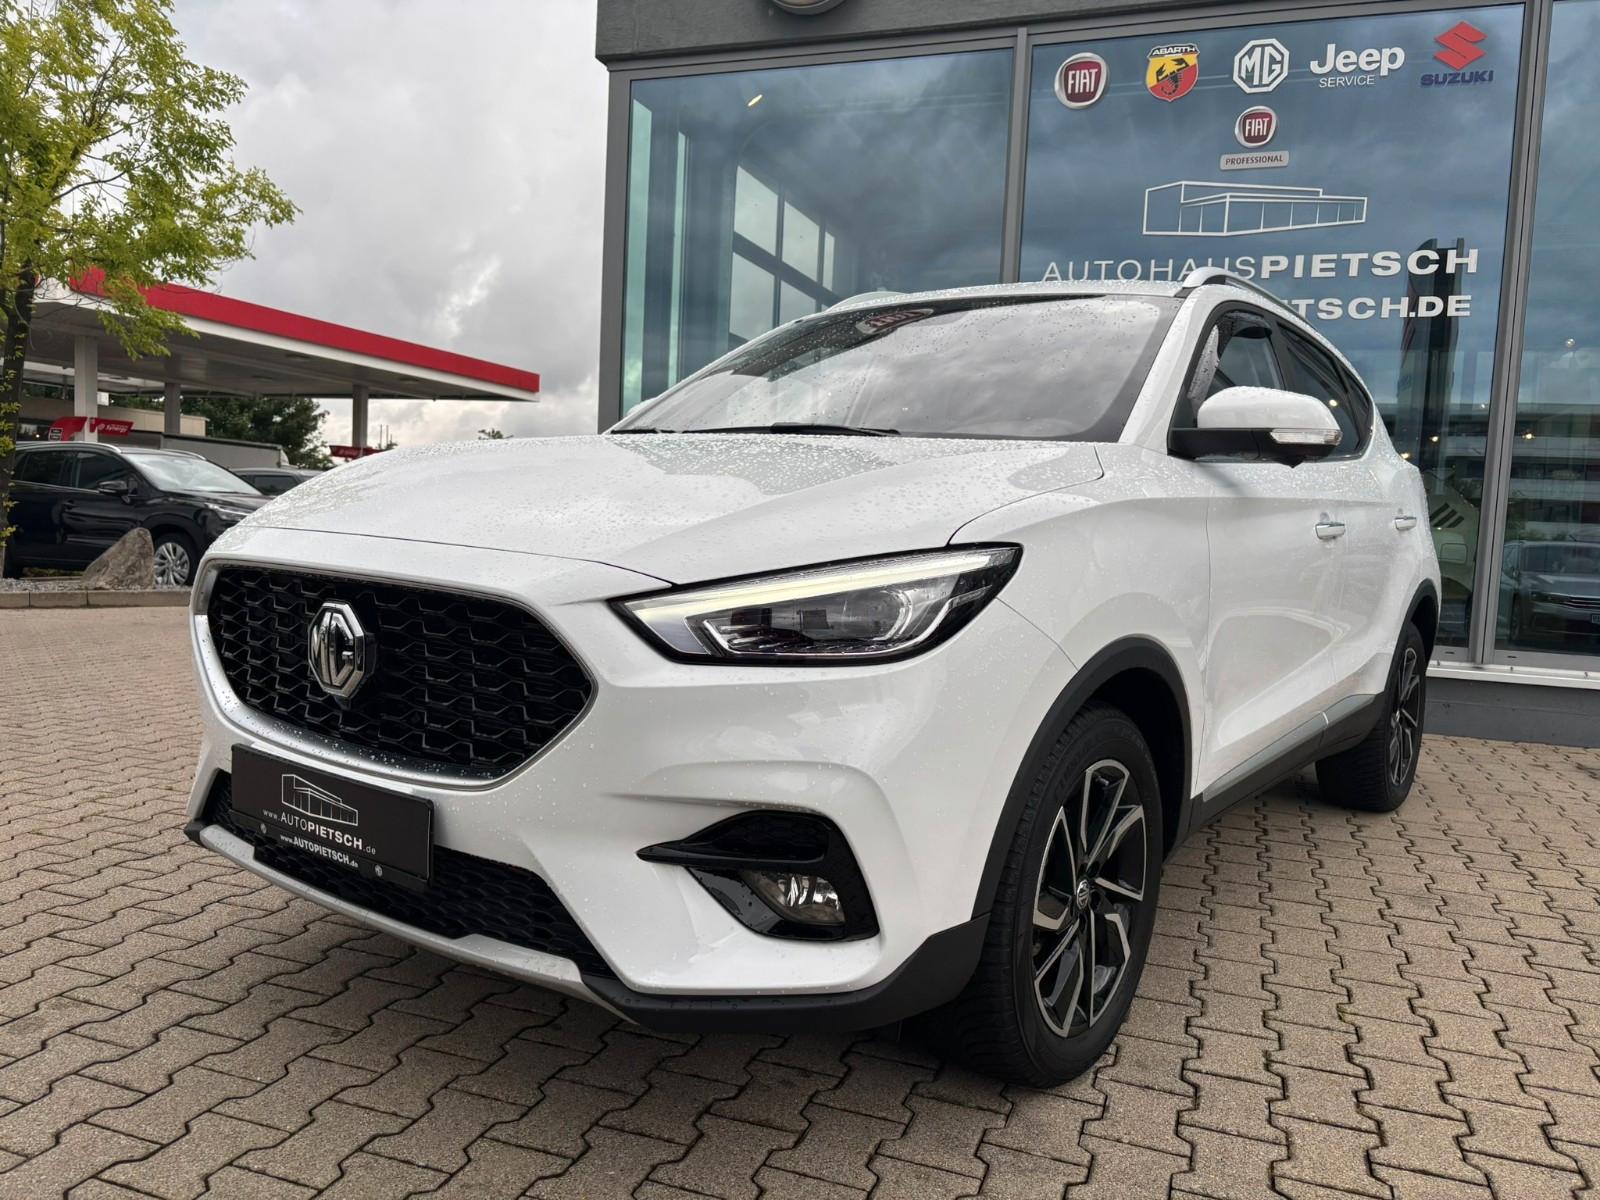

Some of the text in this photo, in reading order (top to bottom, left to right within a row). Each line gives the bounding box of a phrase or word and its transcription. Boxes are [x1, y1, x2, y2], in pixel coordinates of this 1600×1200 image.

[1152, 46, 1196, 56] ABARTH
[1310, 43, 1405, 76] Jeep
[1239, 46, 1283, 87] MG
[1067, 68, 1098, 95] FIAT
[1319, 74, 1375, 88] SERVICE
[1420, 70, 1494, 87] SUZUKI
[1245, 117, 1270, 137] FIAT
[1225, 154, 1283, 166] PROFESSIONAL
[309, 609, 355, 689] MG
